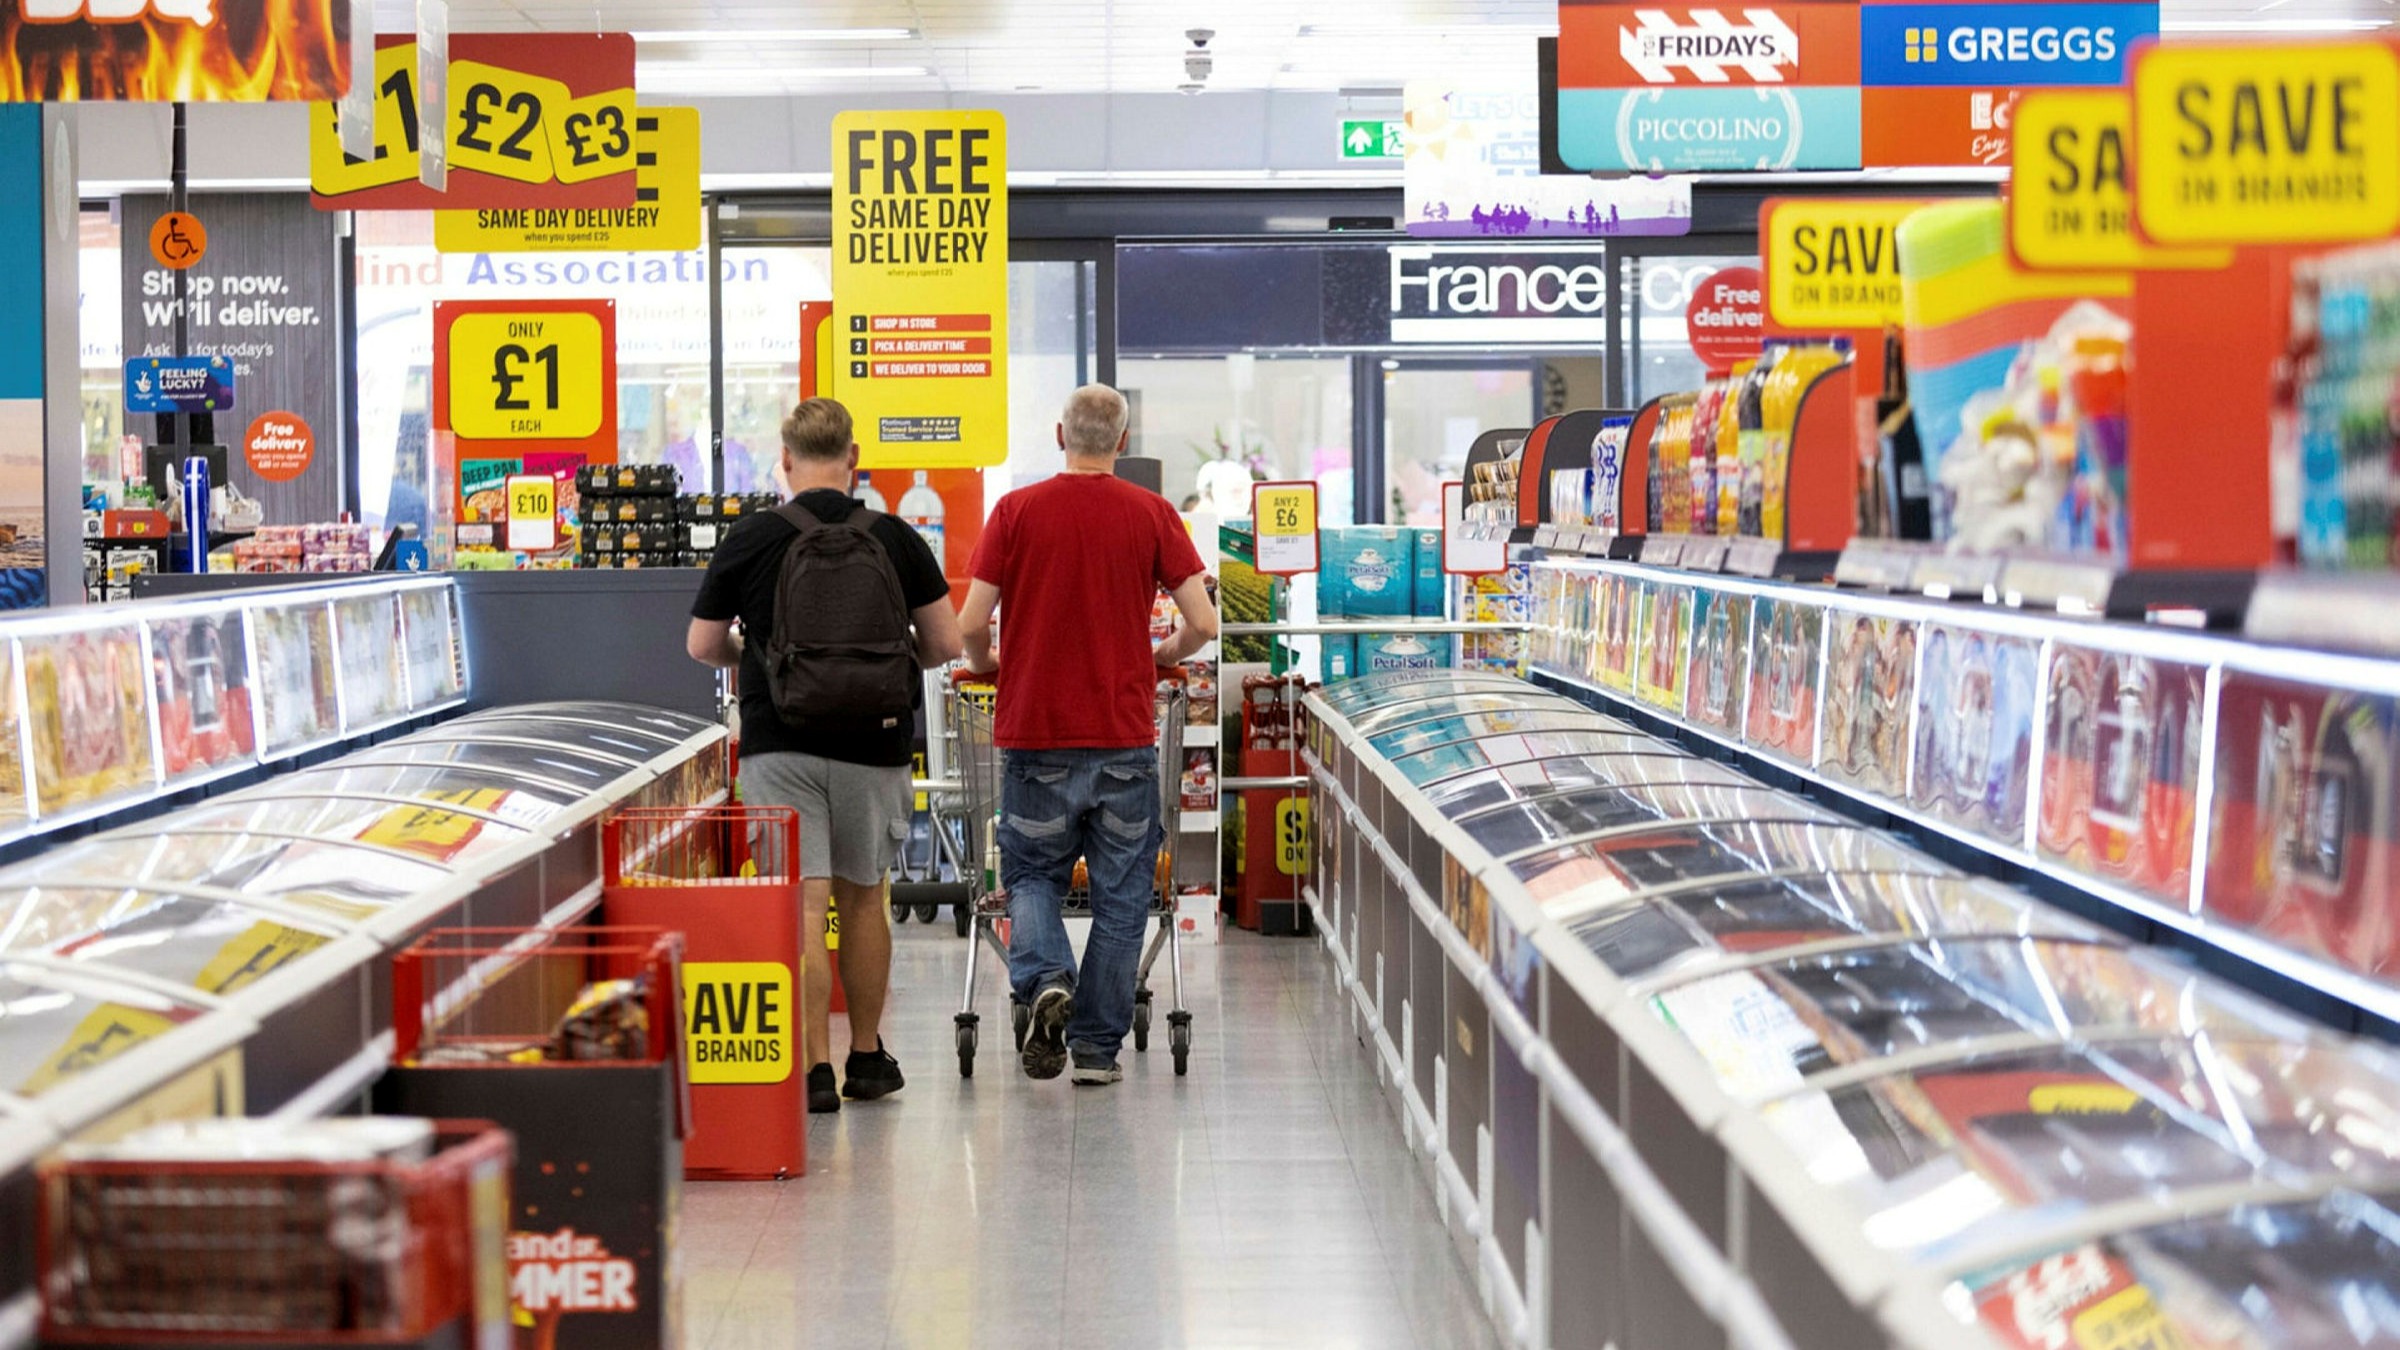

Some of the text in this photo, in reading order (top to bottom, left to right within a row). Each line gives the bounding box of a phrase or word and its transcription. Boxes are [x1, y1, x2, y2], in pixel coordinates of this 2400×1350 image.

[1659, 35, 1776, 57] FRIDAYS
[1948, 27, 2116, 62] GREGGS
[455, 83, 542, 162] £2
[565, 106, 631, 166] £3
[2177, 76, 2364, 159] SAVE
[1637, 118, 1781, 141] PICCOLINO
[848, 129, 990, 195] FREE
[2046, 125, 2126, 194] SA
[478, 207, 660, 229] SAME DAY DELIVERY
[850, 198, 991, 229] SAME DAY
[524, 231, 610, 243] when you spend £25
[849, 232, 988, 264] DELIVERY
[887, 269, 904, 277] when
[906, 270, 918, 278] you
[920, 269, 939, 278] spend
[222, 275, 289, 295] now.
[1714, 285, 1761, 305] Free
[1829, 285, 1902, 304] BRAND
[142, 299, 320, 326] W'll deliver.
[508, 322, 543, 338] ONLY
[854, 317, 937, 329] 1 SHOP IN STORE
[144, 343, 171, 357] Ask
[196, 342, 217, 356] for
[222, 341, 274, 359] today's
[855, 340, 967, 352] 2 PICK A DELIVERY TIME
[159, 368, 208, 379] FEELING
[491, 344, 559, 410] £1
[855, 363, 986, 375] 3 WE DELIVER TO YOUR DOOR
[159, 379, 205, 390] LUCKY?
[263, 421, 295, 436] Free
[510, 420, 541, 433] EACH
[251, 436, 307, 453] delivery
[462, 466, 491, 486] DEEP
[493, 460, 518, 479] PAN
[518, 494, 548, 514] £10
[1274, 496, 1300, 507] ANY 2
[1276, 508, 1298, 527] £6
[682, 983, 780, 1034] AVE
[696, 1039, 780, 1062] BRANDS
